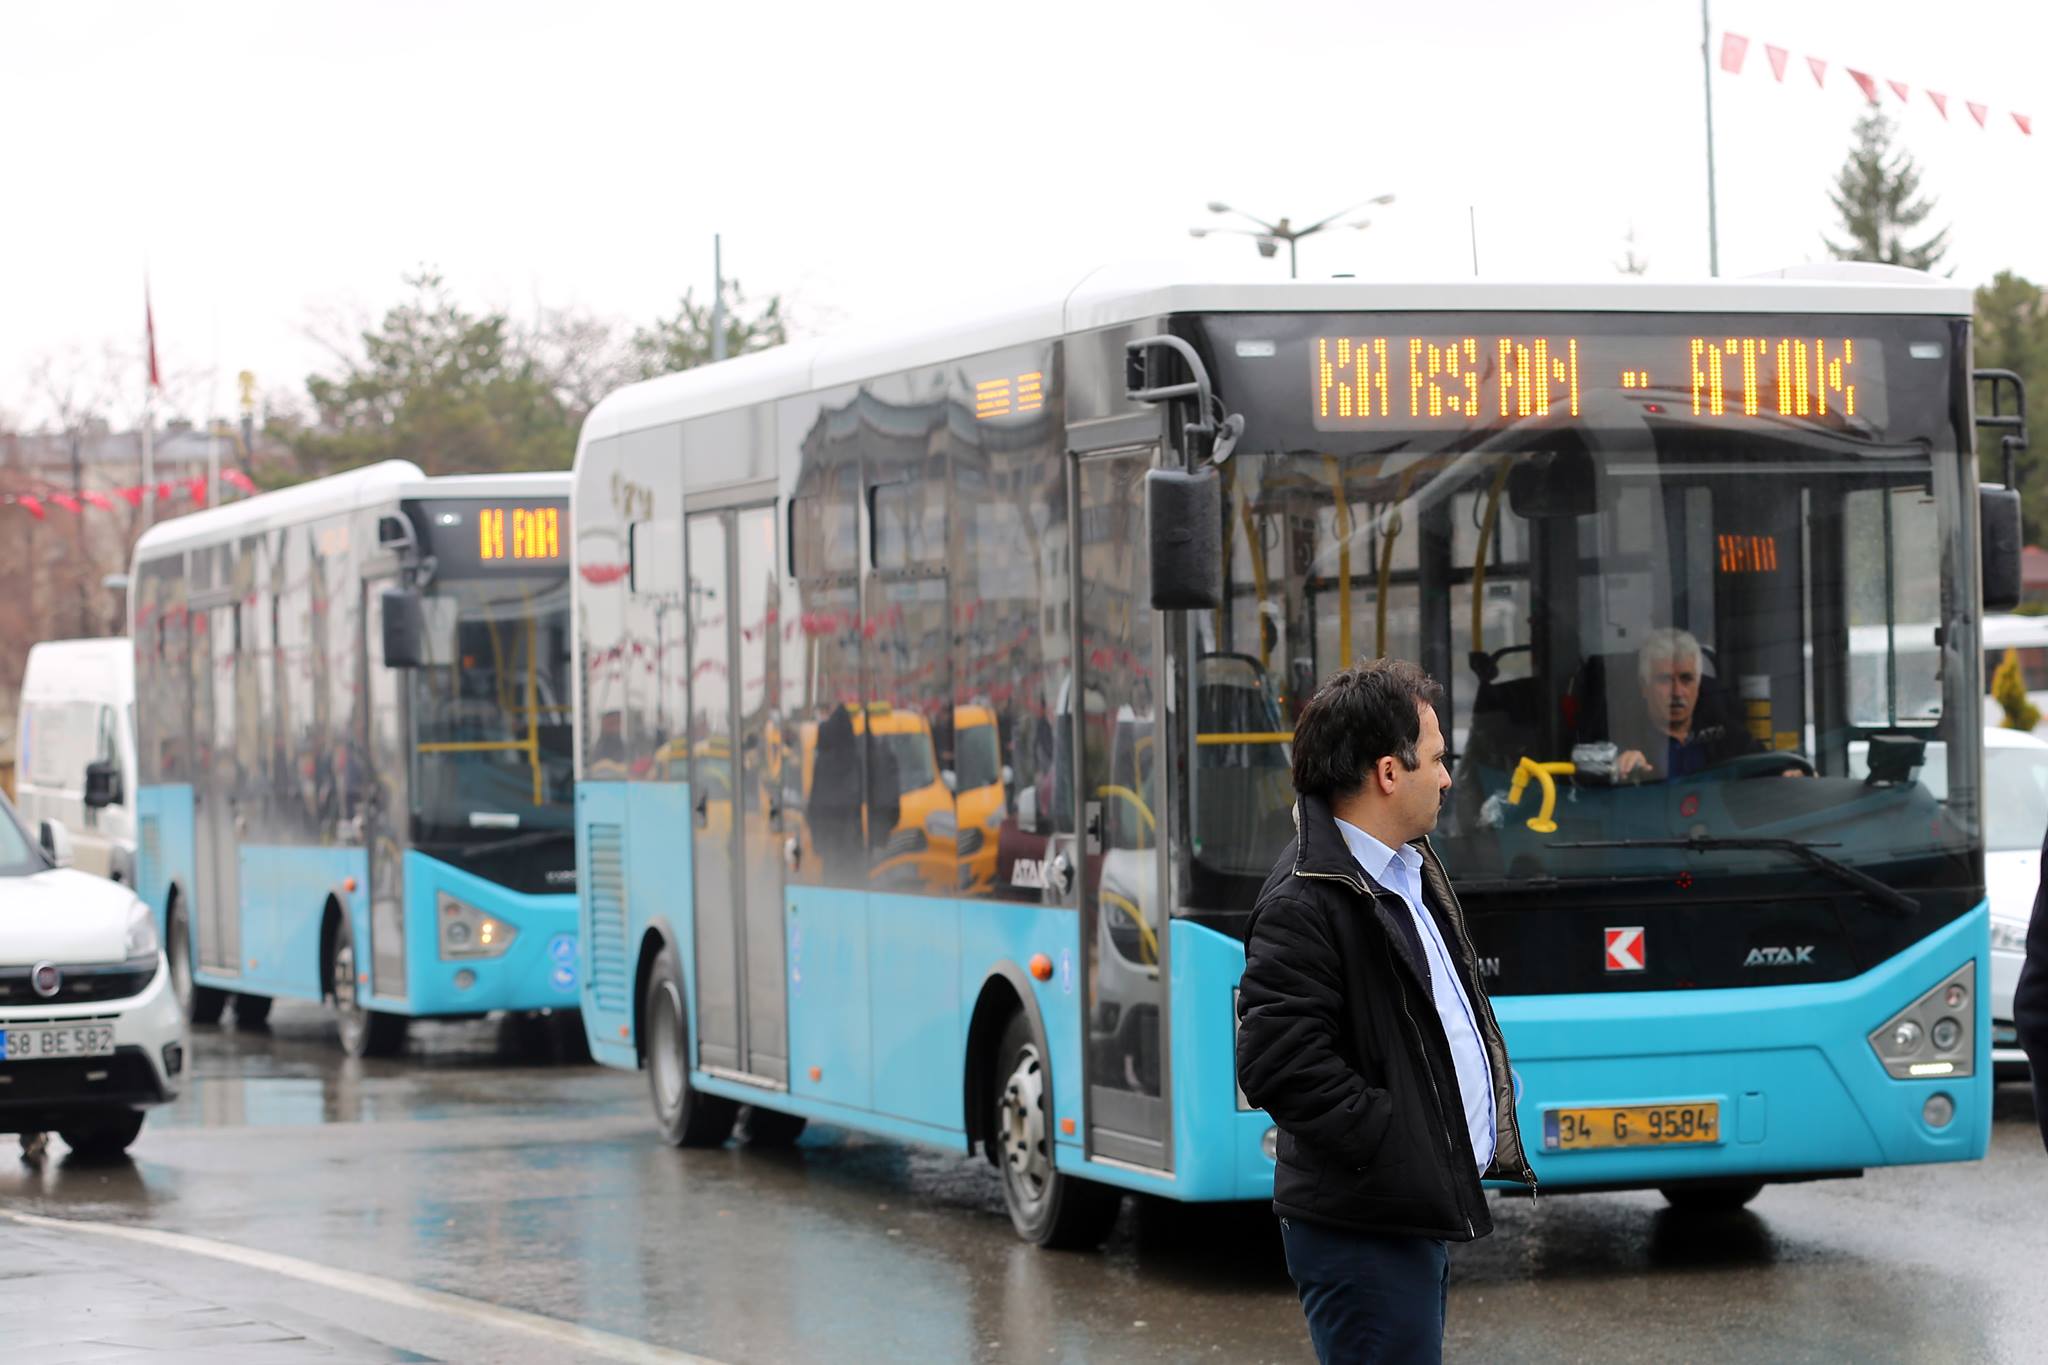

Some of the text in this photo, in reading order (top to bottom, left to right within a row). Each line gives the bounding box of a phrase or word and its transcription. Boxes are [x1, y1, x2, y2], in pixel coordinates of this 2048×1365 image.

[1743, 945, 1816, 967] ATAK
[6, 1029, 113, 1056] 58 BE 582
[1560, 1108, 1712, 1143] 34 G 9584
